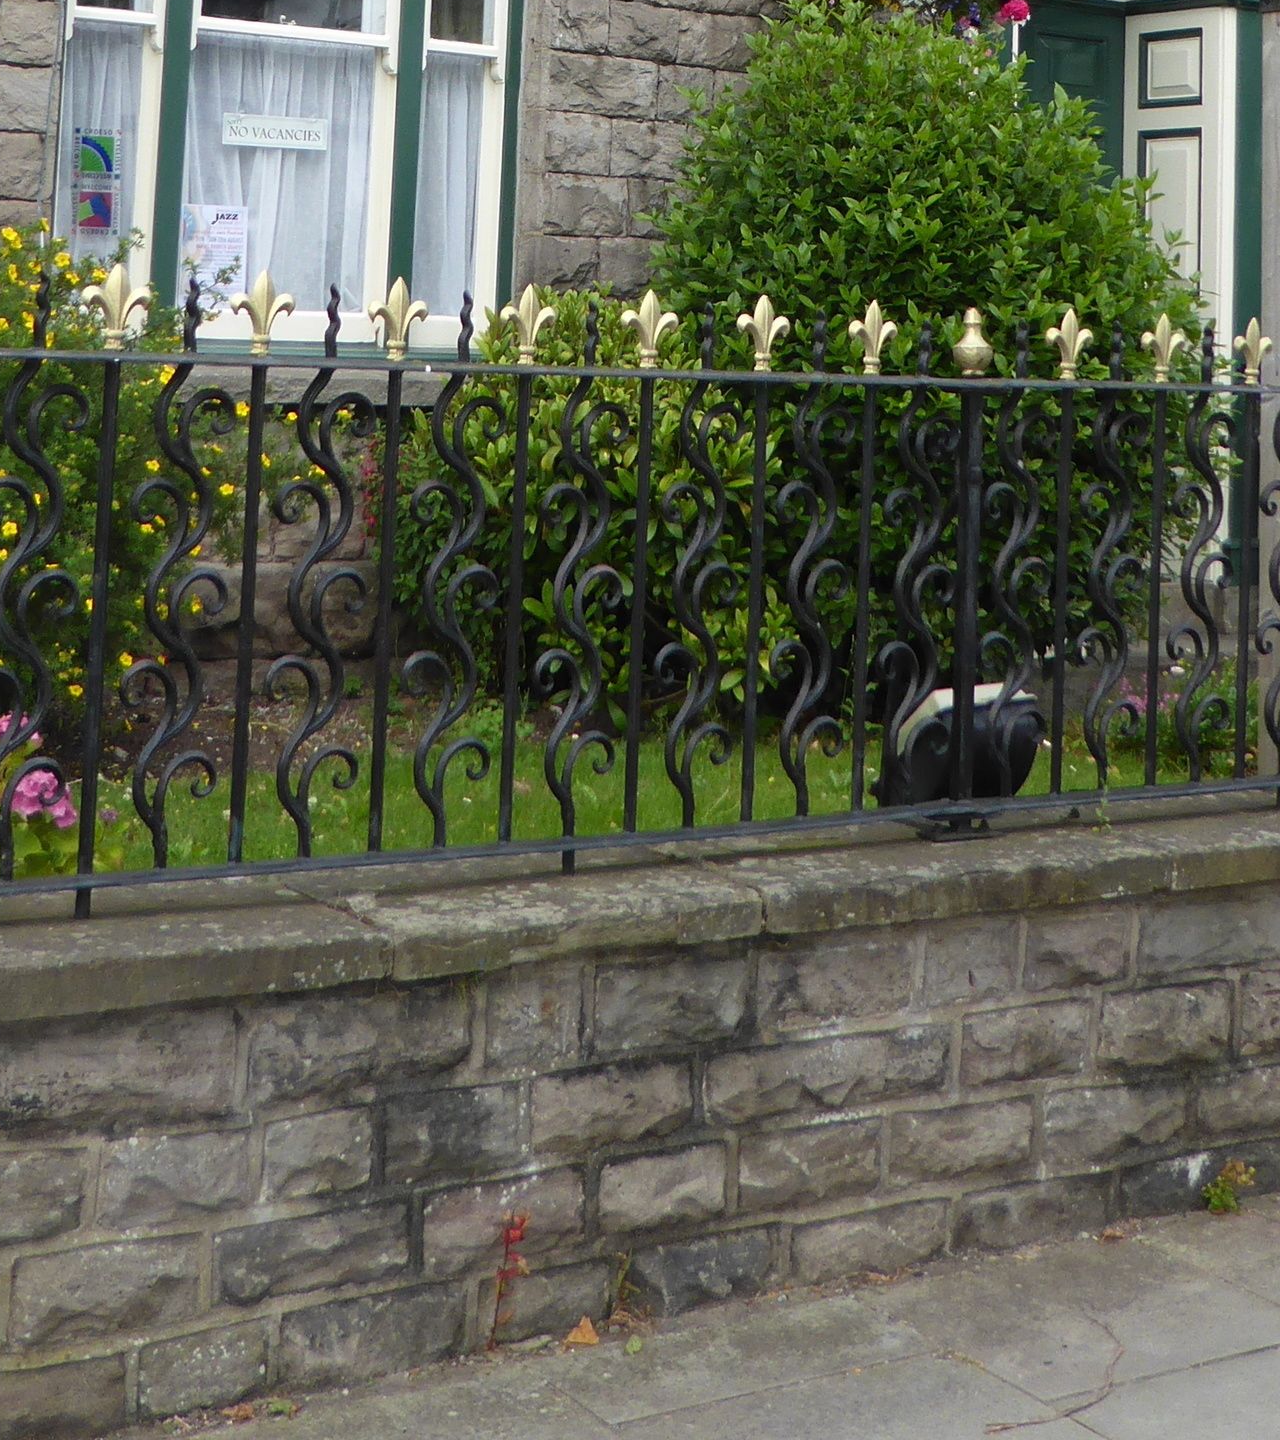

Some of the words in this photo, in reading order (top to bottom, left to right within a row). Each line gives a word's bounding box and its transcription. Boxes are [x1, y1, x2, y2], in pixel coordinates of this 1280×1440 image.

[229, 125, 249, 138] NO
[252, 127, 321, 142] VACANCIES
[211, 213, 238, 225] JAZZ
